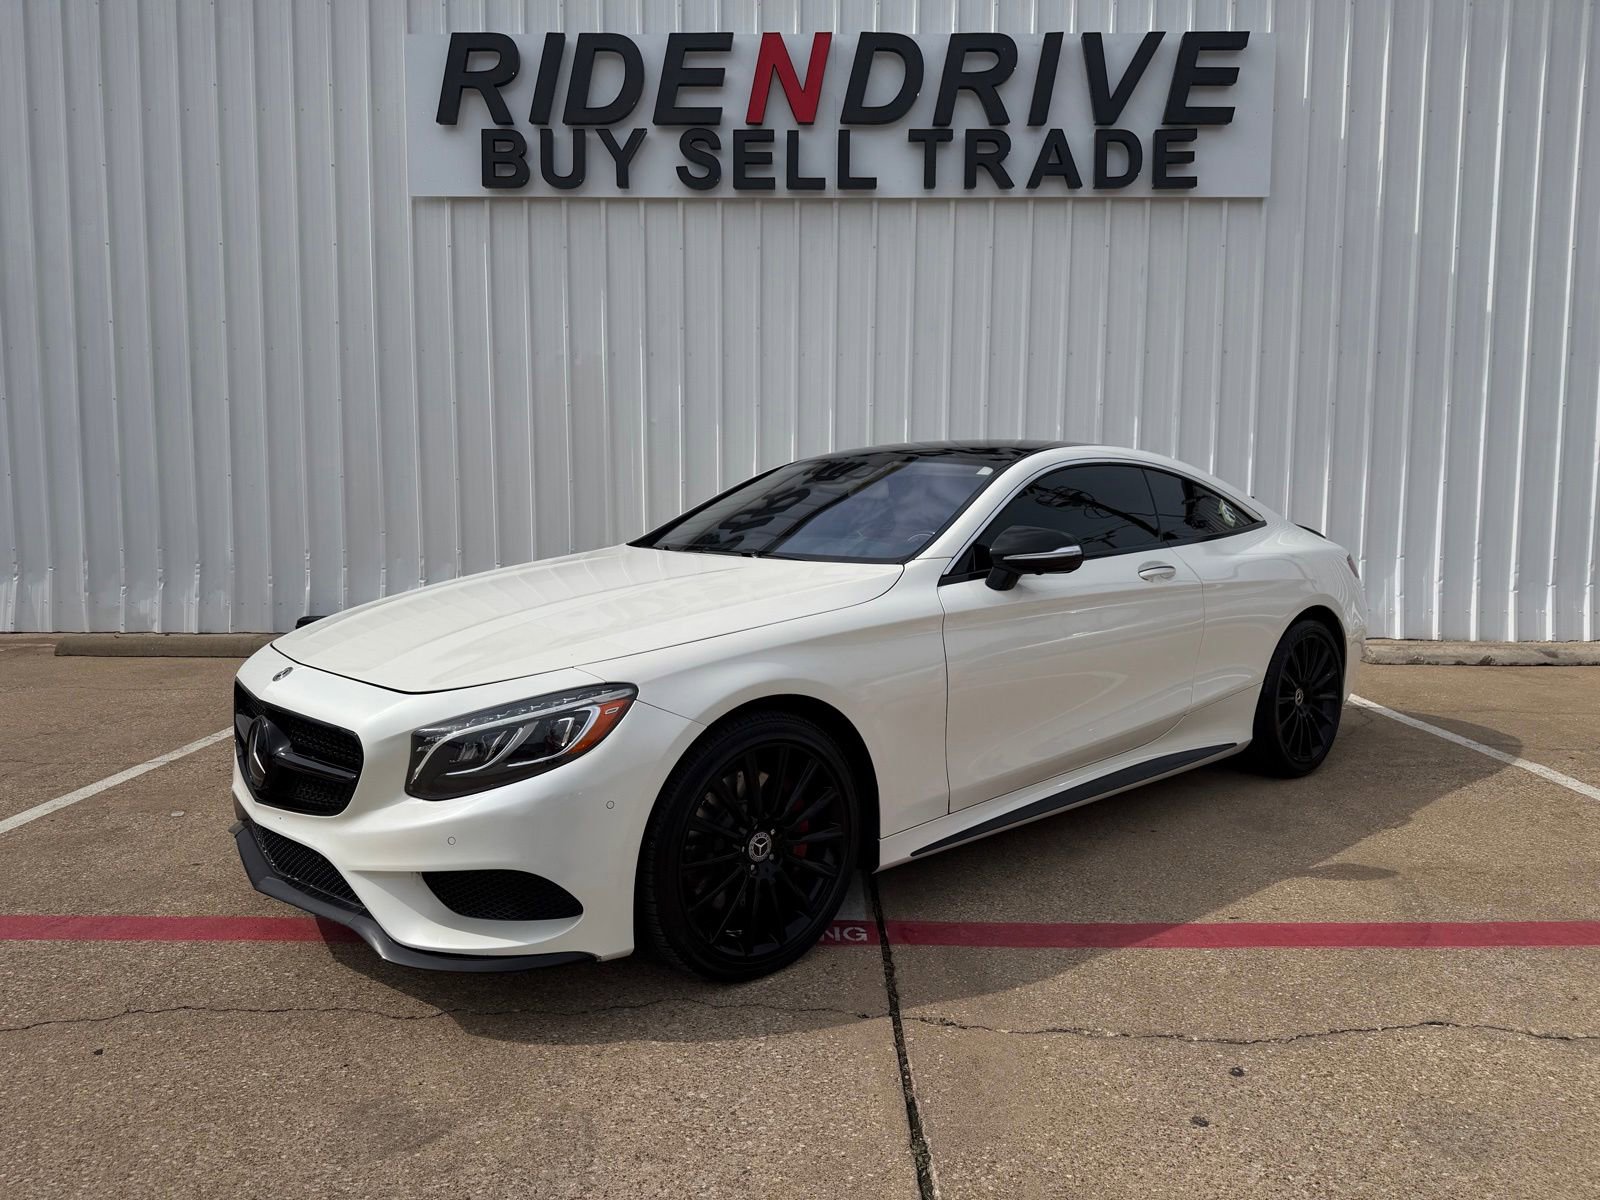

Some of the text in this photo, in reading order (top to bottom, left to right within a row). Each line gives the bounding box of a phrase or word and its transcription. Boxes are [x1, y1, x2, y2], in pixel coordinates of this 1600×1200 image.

[436, 31, 1250, 126] RIDENDRIVE
[481, 127, 1197, 190] BUY SELL TRADE
